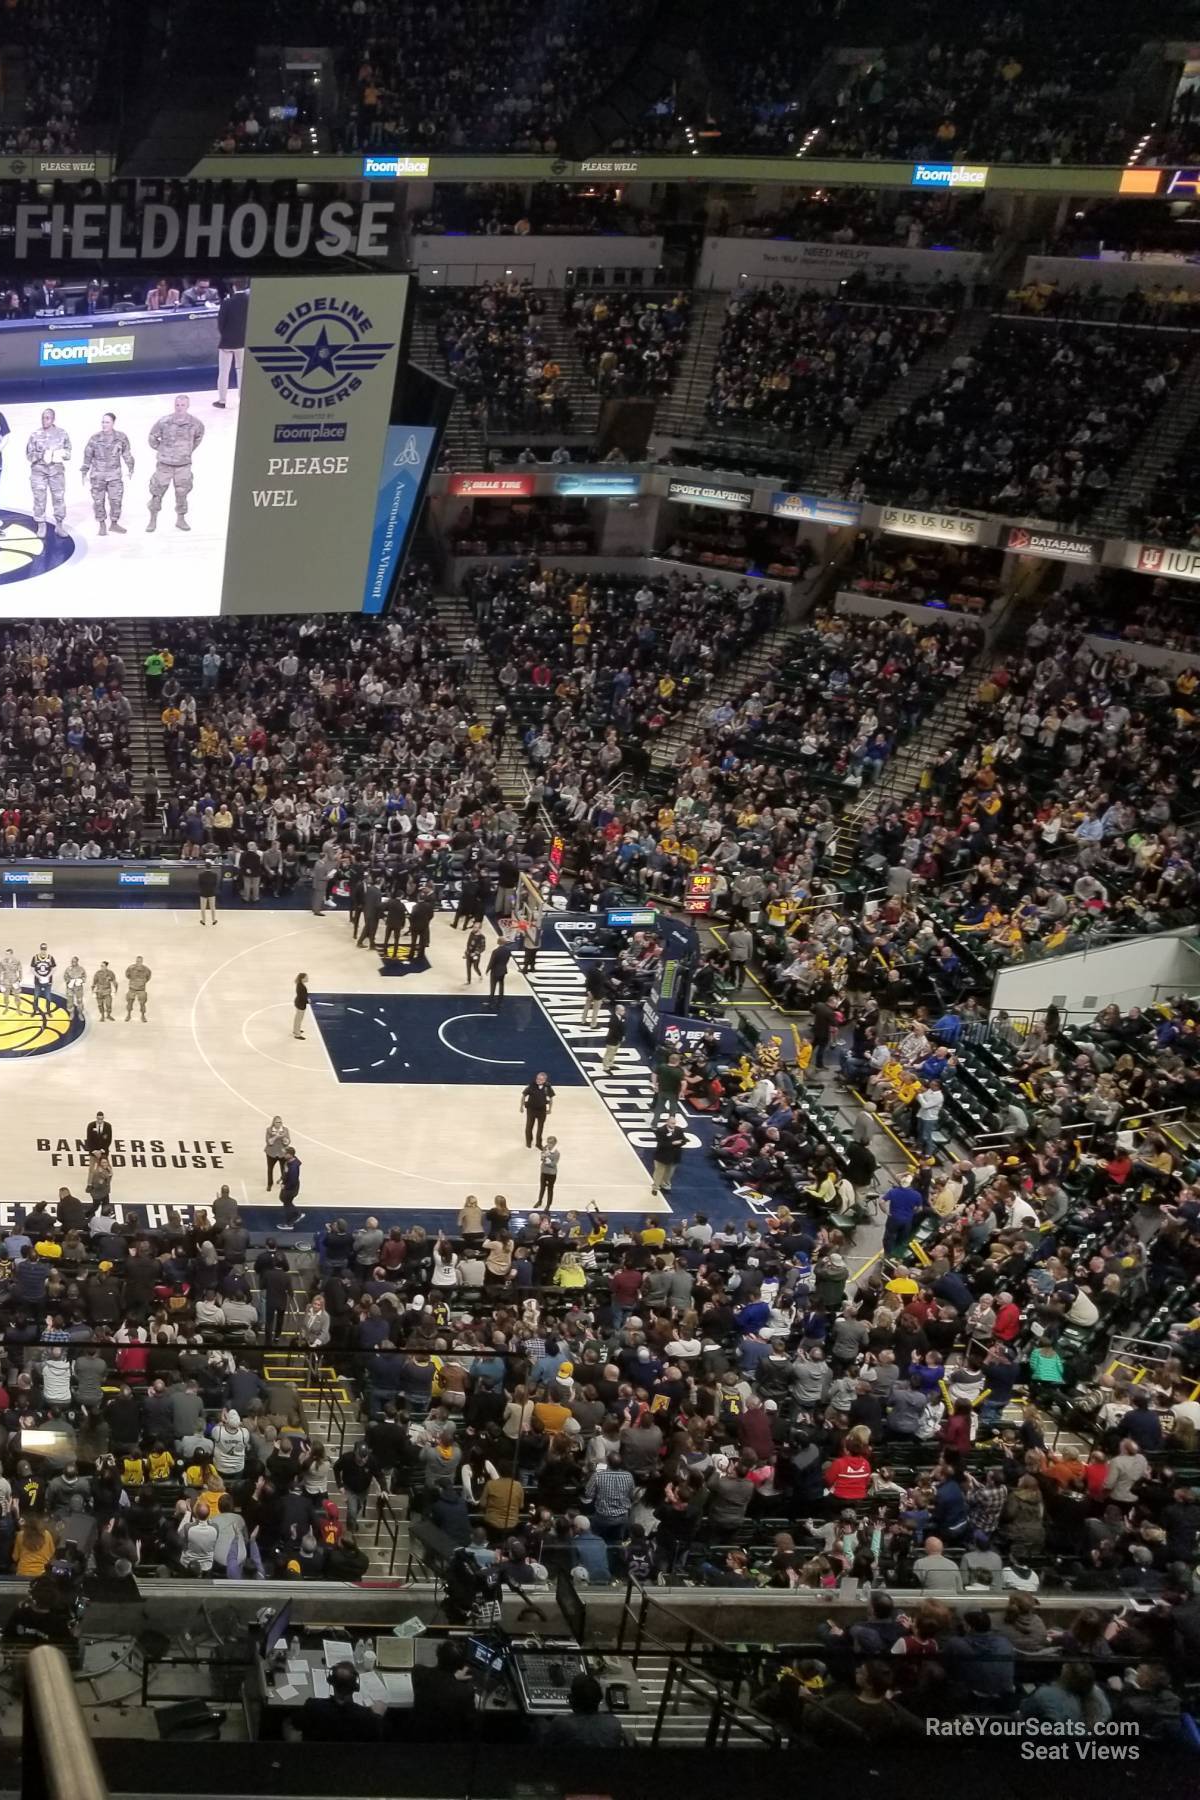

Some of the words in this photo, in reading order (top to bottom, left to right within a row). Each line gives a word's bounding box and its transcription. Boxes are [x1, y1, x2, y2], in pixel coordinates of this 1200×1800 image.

[40, 162, 71, 171] PLEASE
[366, 158, 427, 176] roomplace
[582, 162, 612, 171] PLEASE
[614, 162, 638, 171] WELC
[916, 167, 985, 186] roomplace
[14, 201, 396, 259] FIELDHOUSE
[274, 297, 374, 338] SIDELINE
[43, 338, 132, 363] roomplace
[270, 374, 363, 409] SOLDIERS
[276, 422, 345, 442] roomplace
[267, 456, 350, 476] PLEASE
[472, 480, 500, 490] BELLE
[500, 480, 522, 490] TIRE
[669, 484, 700, 496] SPORT
[701, 488, 752, 502] GRAPHICS
[252, 490, 298, 508] WEL
[1030, 536, 1093, 553] DATABANK
[372, 556, 390, 598] Vincent
[554, 922, 596, 930] GEICO
[36, 1138, 165, 1154] BANERS
[178, 1140, 234, 1154] LIFE
[51, 1153, 225, 1169] FIEDHOUSE
[28, 1489, 38, 1506] 7
[326, 1532, 335, 1544] 4
